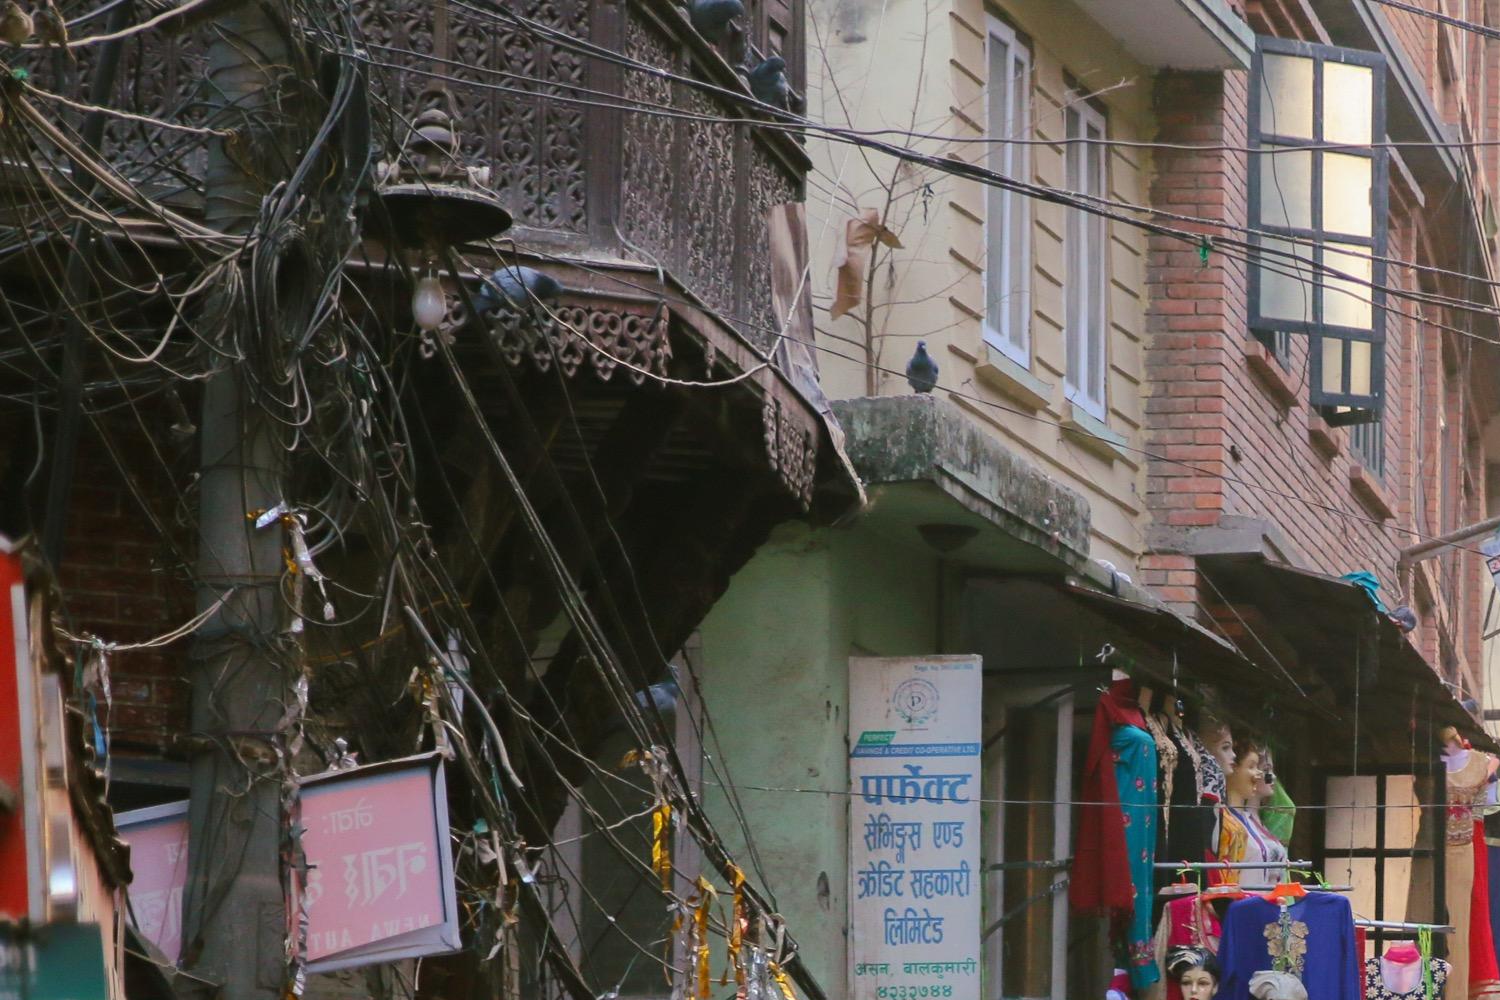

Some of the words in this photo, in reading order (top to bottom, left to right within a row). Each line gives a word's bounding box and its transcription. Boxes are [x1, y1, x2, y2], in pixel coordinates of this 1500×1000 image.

[933, 821, 964, 848] एण्ड
[858, 860, 904, 899] क्रेडिट
[910, 860, 970, 899] सहकारी
[884, 907, 944, 946] लिमिटेड
[877, 985, 952, 1000] ४२३२७४४
